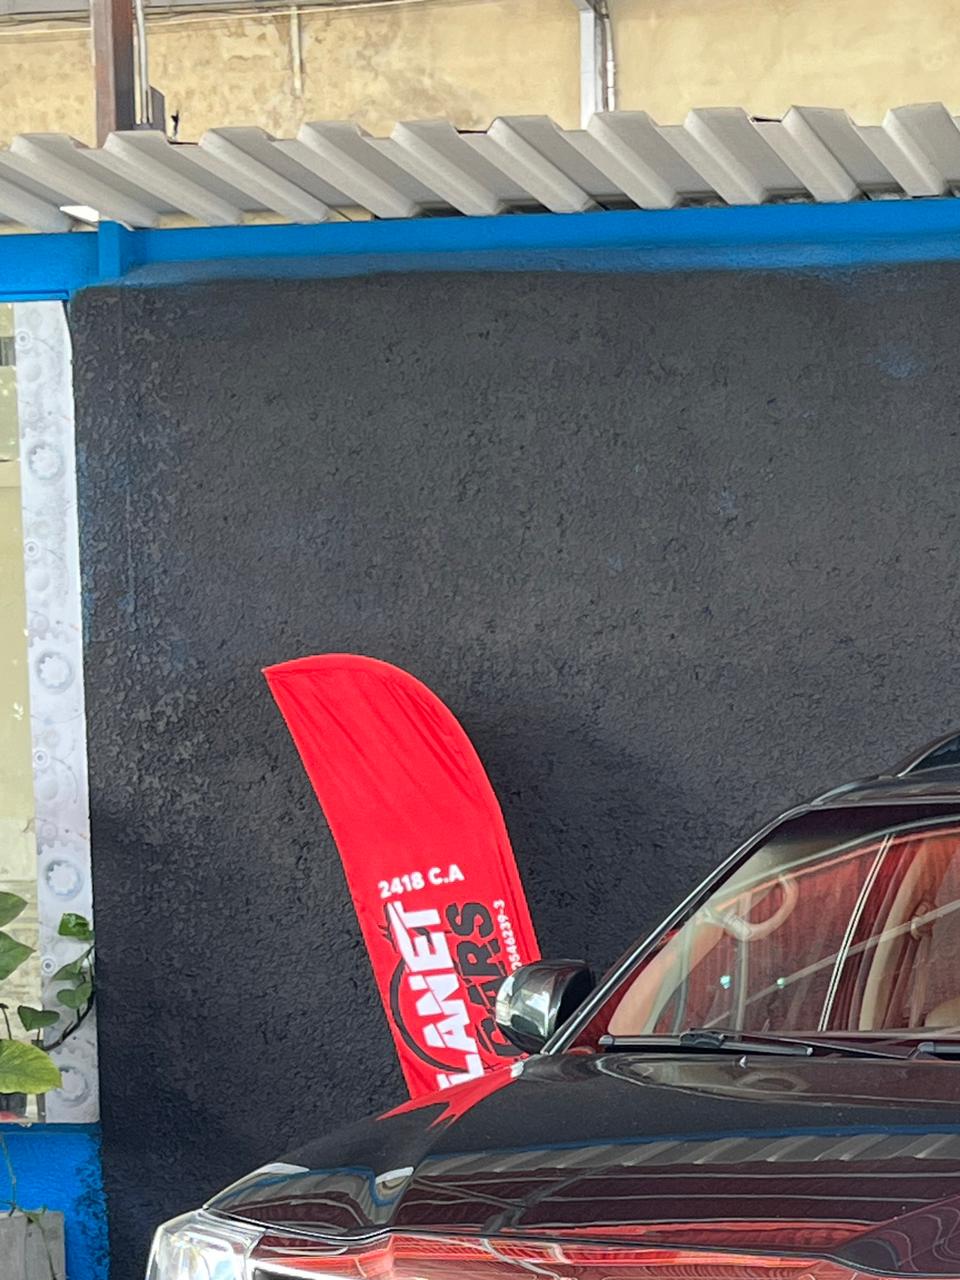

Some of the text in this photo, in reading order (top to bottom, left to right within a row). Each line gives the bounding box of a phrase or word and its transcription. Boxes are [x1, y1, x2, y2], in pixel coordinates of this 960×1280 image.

[378, 863, 465, 898] 2418 C.A
[387, 900, 484, 1091] LANET
